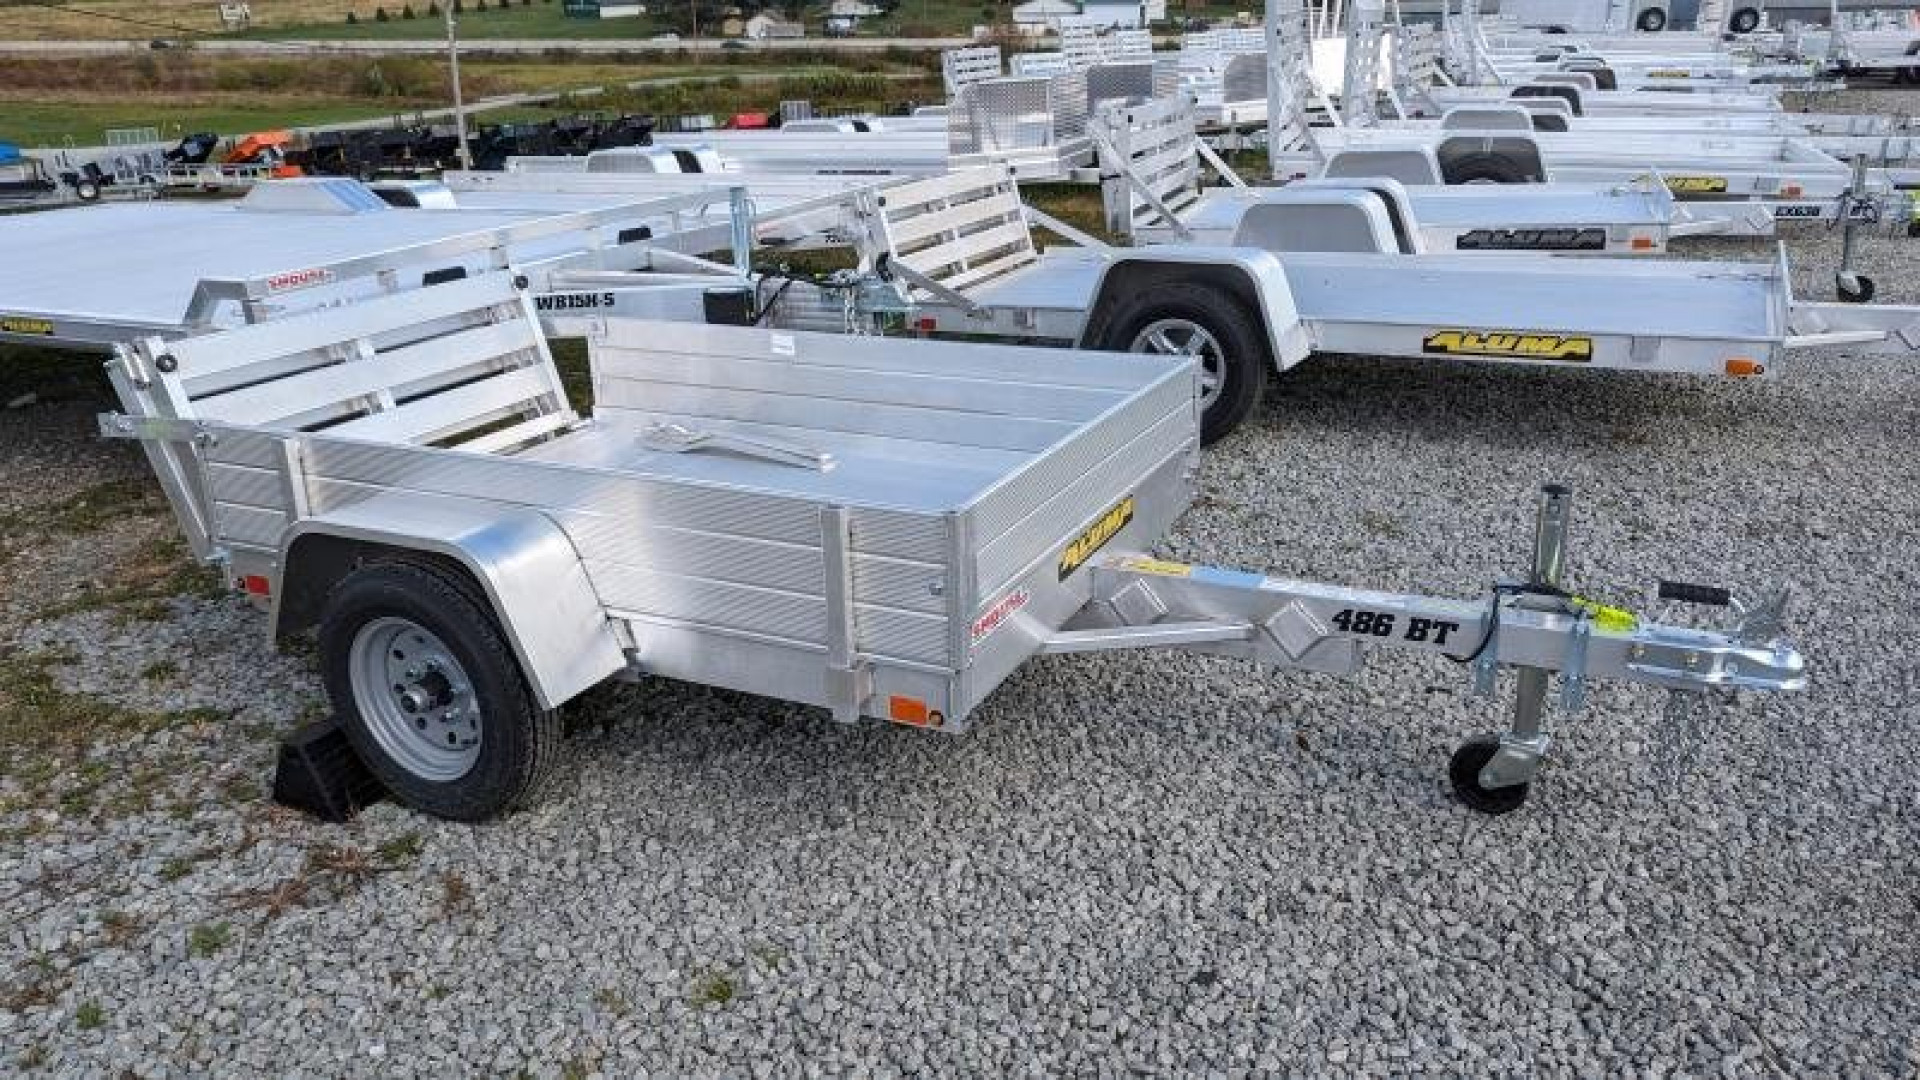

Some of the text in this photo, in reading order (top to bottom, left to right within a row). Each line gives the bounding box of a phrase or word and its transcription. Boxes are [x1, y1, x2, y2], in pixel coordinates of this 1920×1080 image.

[1457, 229, 1606, 250] ALUMA
[1423, 330, 1592, 362] ALUMA
[1058, 495, 1134, 582] ALUMA
[1332, 609, 1460, 645] 486 BT
